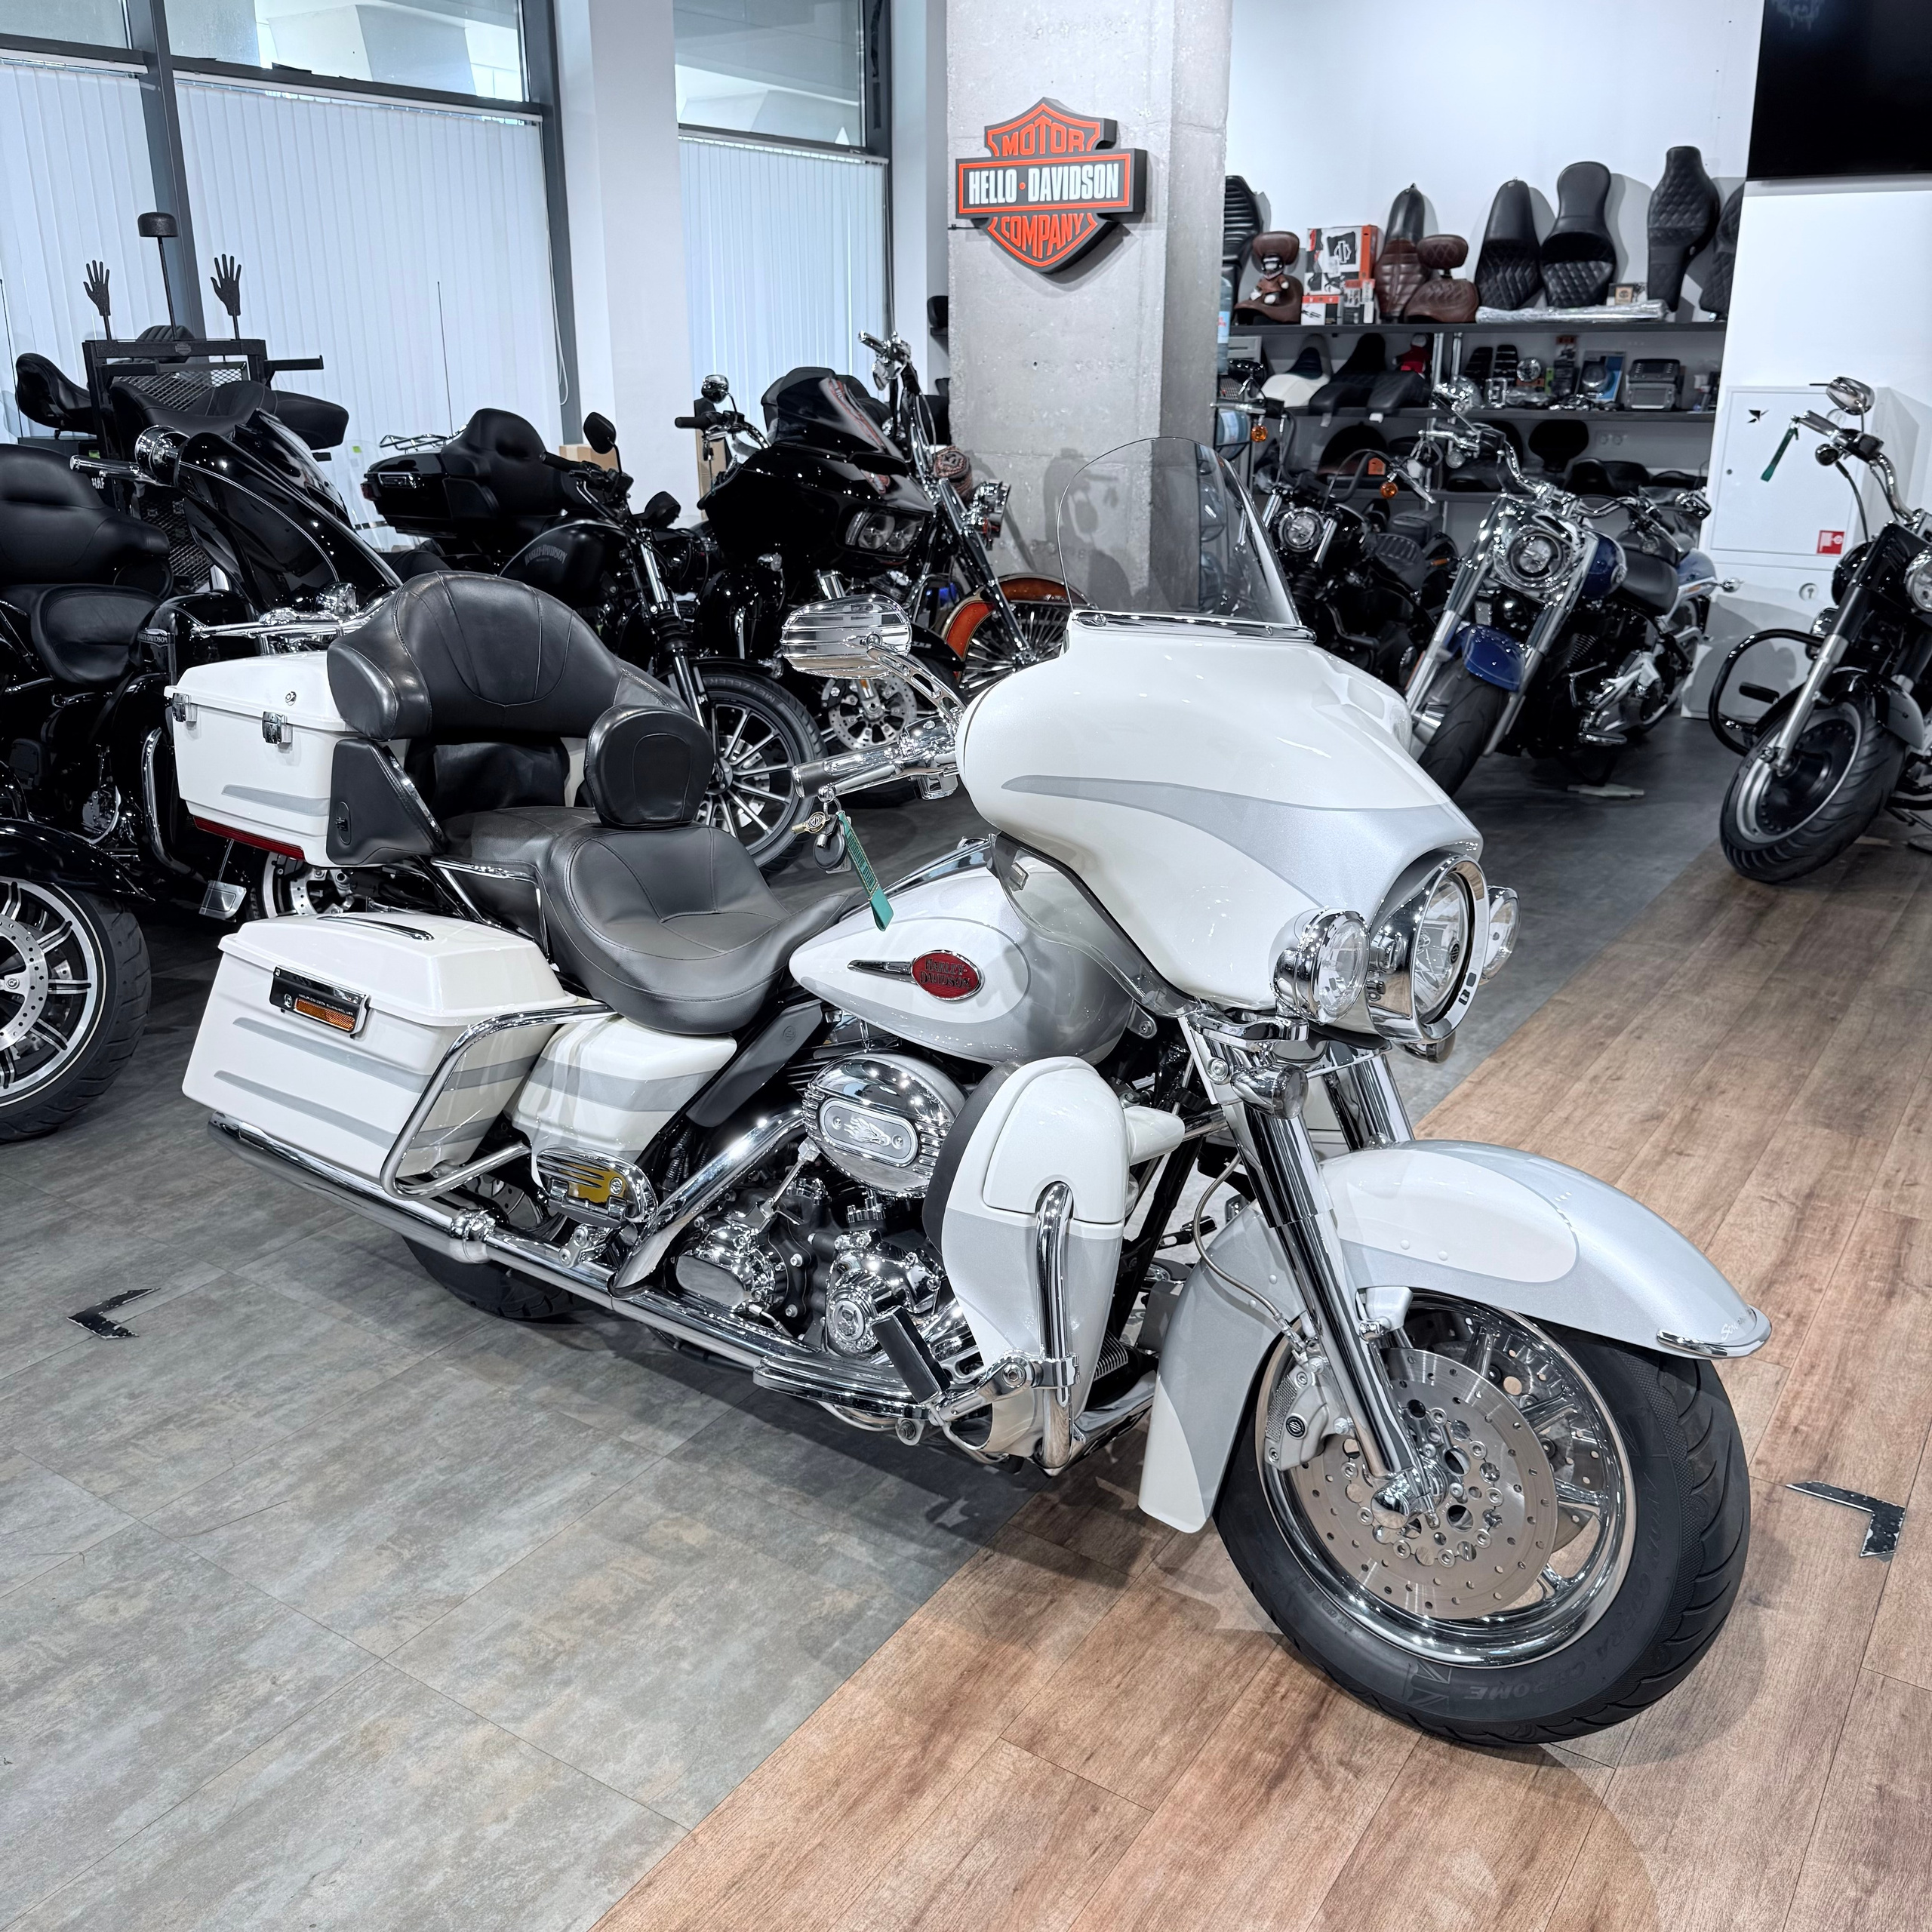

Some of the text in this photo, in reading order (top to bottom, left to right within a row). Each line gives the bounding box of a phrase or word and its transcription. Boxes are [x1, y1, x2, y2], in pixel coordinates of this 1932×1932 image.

[1002, 115, 1084, 157] MOTOR
[968, 162, 1119, 205] HELLO DAVIDSON
[1001, 213, 1084, 259] COMPANY
[920, 971, 971, 992] DAVIDSON
